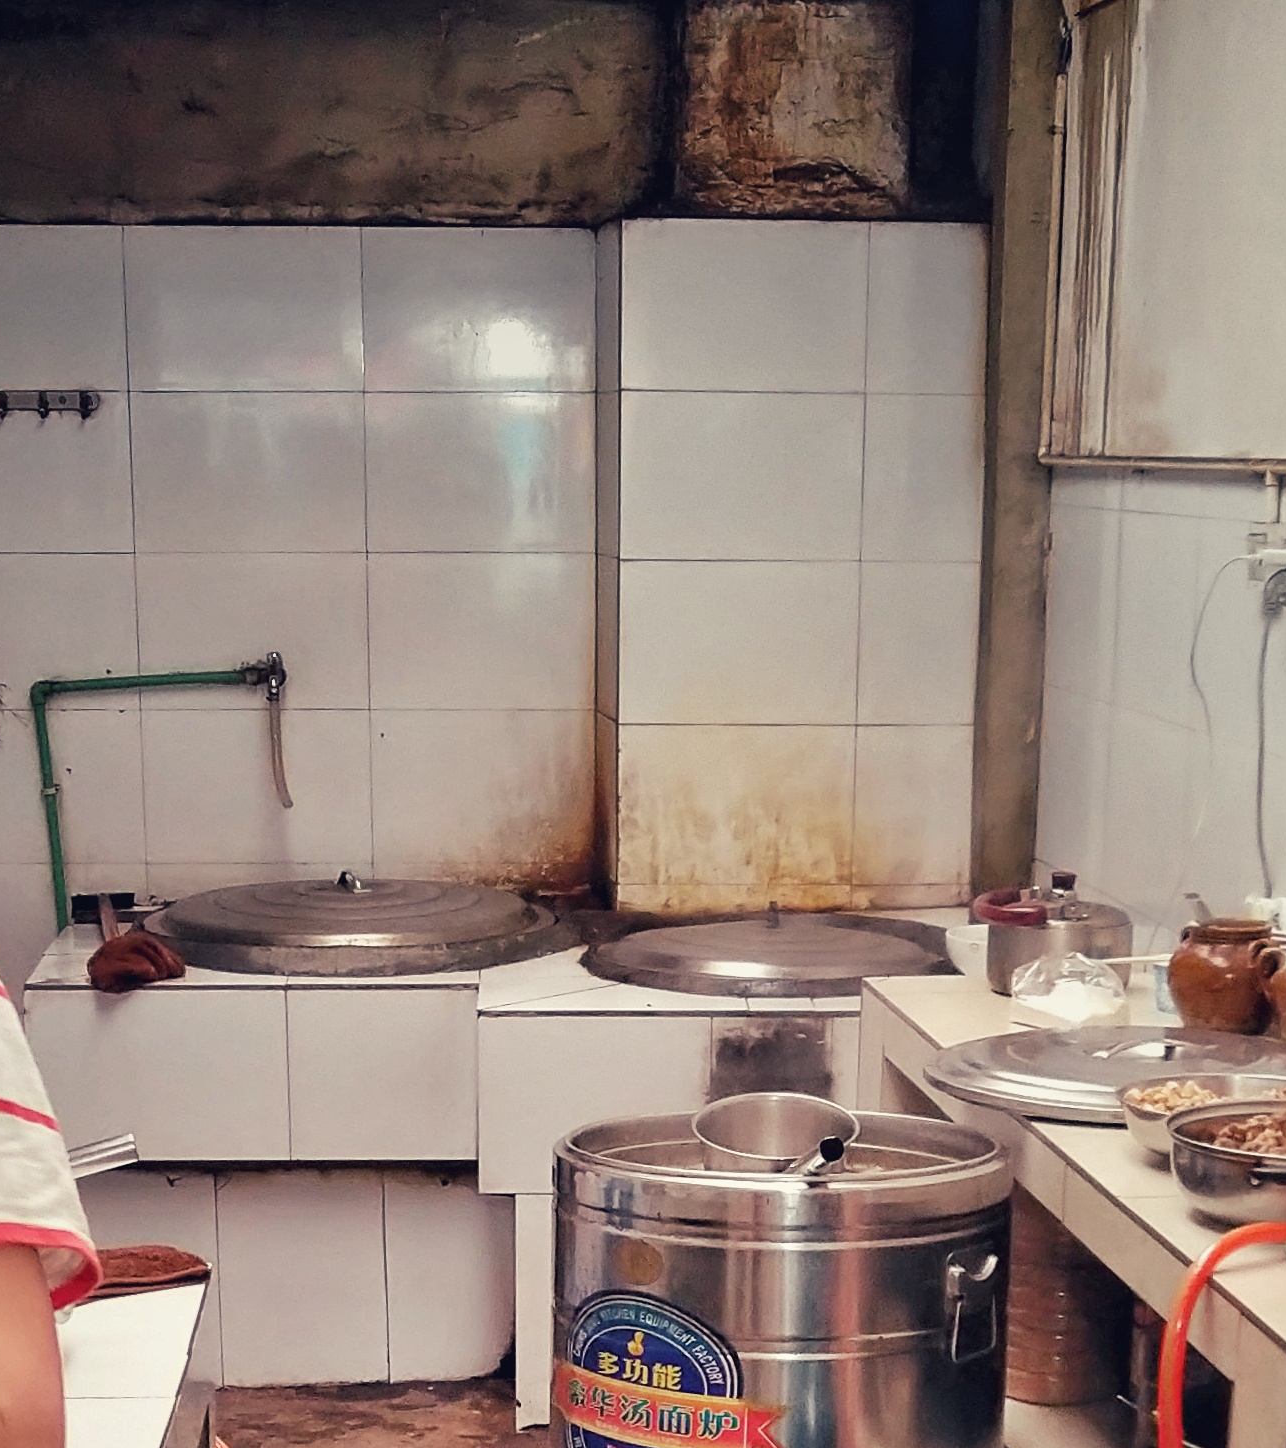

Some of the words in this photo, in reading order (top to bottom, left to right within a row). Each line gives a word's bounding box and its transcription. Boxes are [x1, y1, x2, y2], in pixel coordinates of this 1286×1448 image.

[597, 1350, 683, 1391] 多功能
[639, 1311, 697, 1346] EQUIPMENT
[692, 1344, 725, 1385] FACTORY
